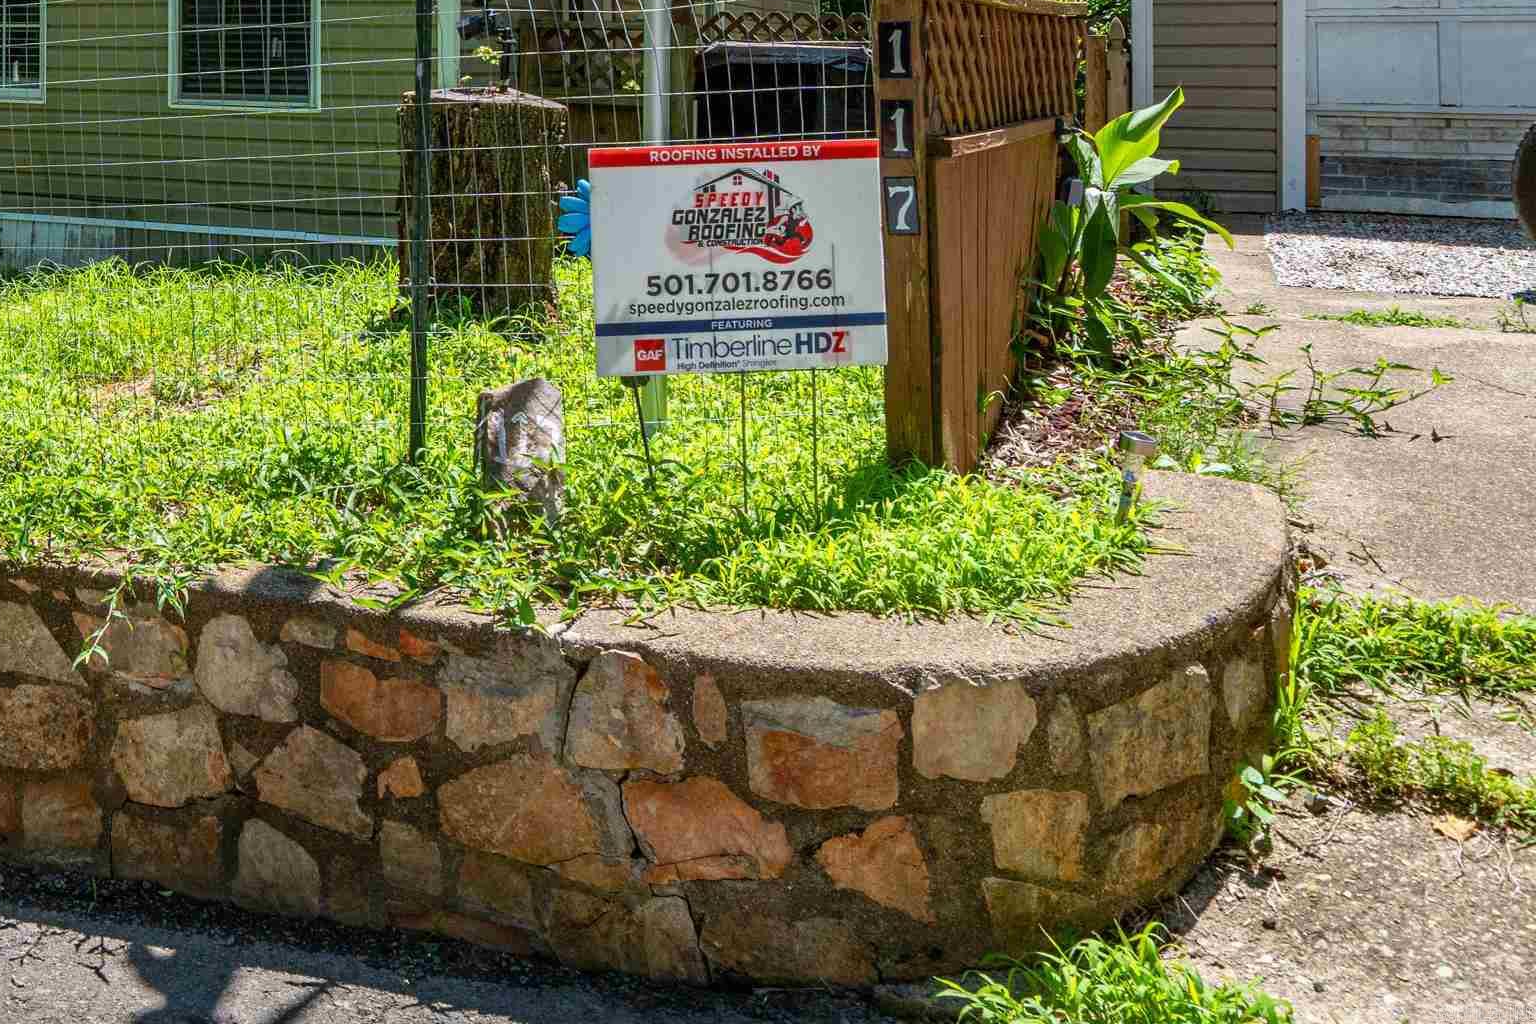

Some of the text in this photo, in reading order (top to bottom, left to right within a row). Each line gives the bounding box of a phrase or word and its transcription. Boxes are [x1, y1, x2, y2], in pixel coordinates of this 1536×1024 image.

[649, 144, 822, 163] ROOFING INSTALLED BY
[695, 191, 765, 208] SPEEDY
[672, 207, 767, 225] GONZALEZ
[688, 223, 767, 240] ROOFING
[706, 238, 765, 247] CONSTRUCTION
[646, 268, 833, 297] 501.701.8766
[629, 294, 846, 317] speedygonzalezroofing.com
[711, 319, 773, 330] FEATURING
[636, 349, 664, 362] GAF
[676, 362, 697, 371] High
